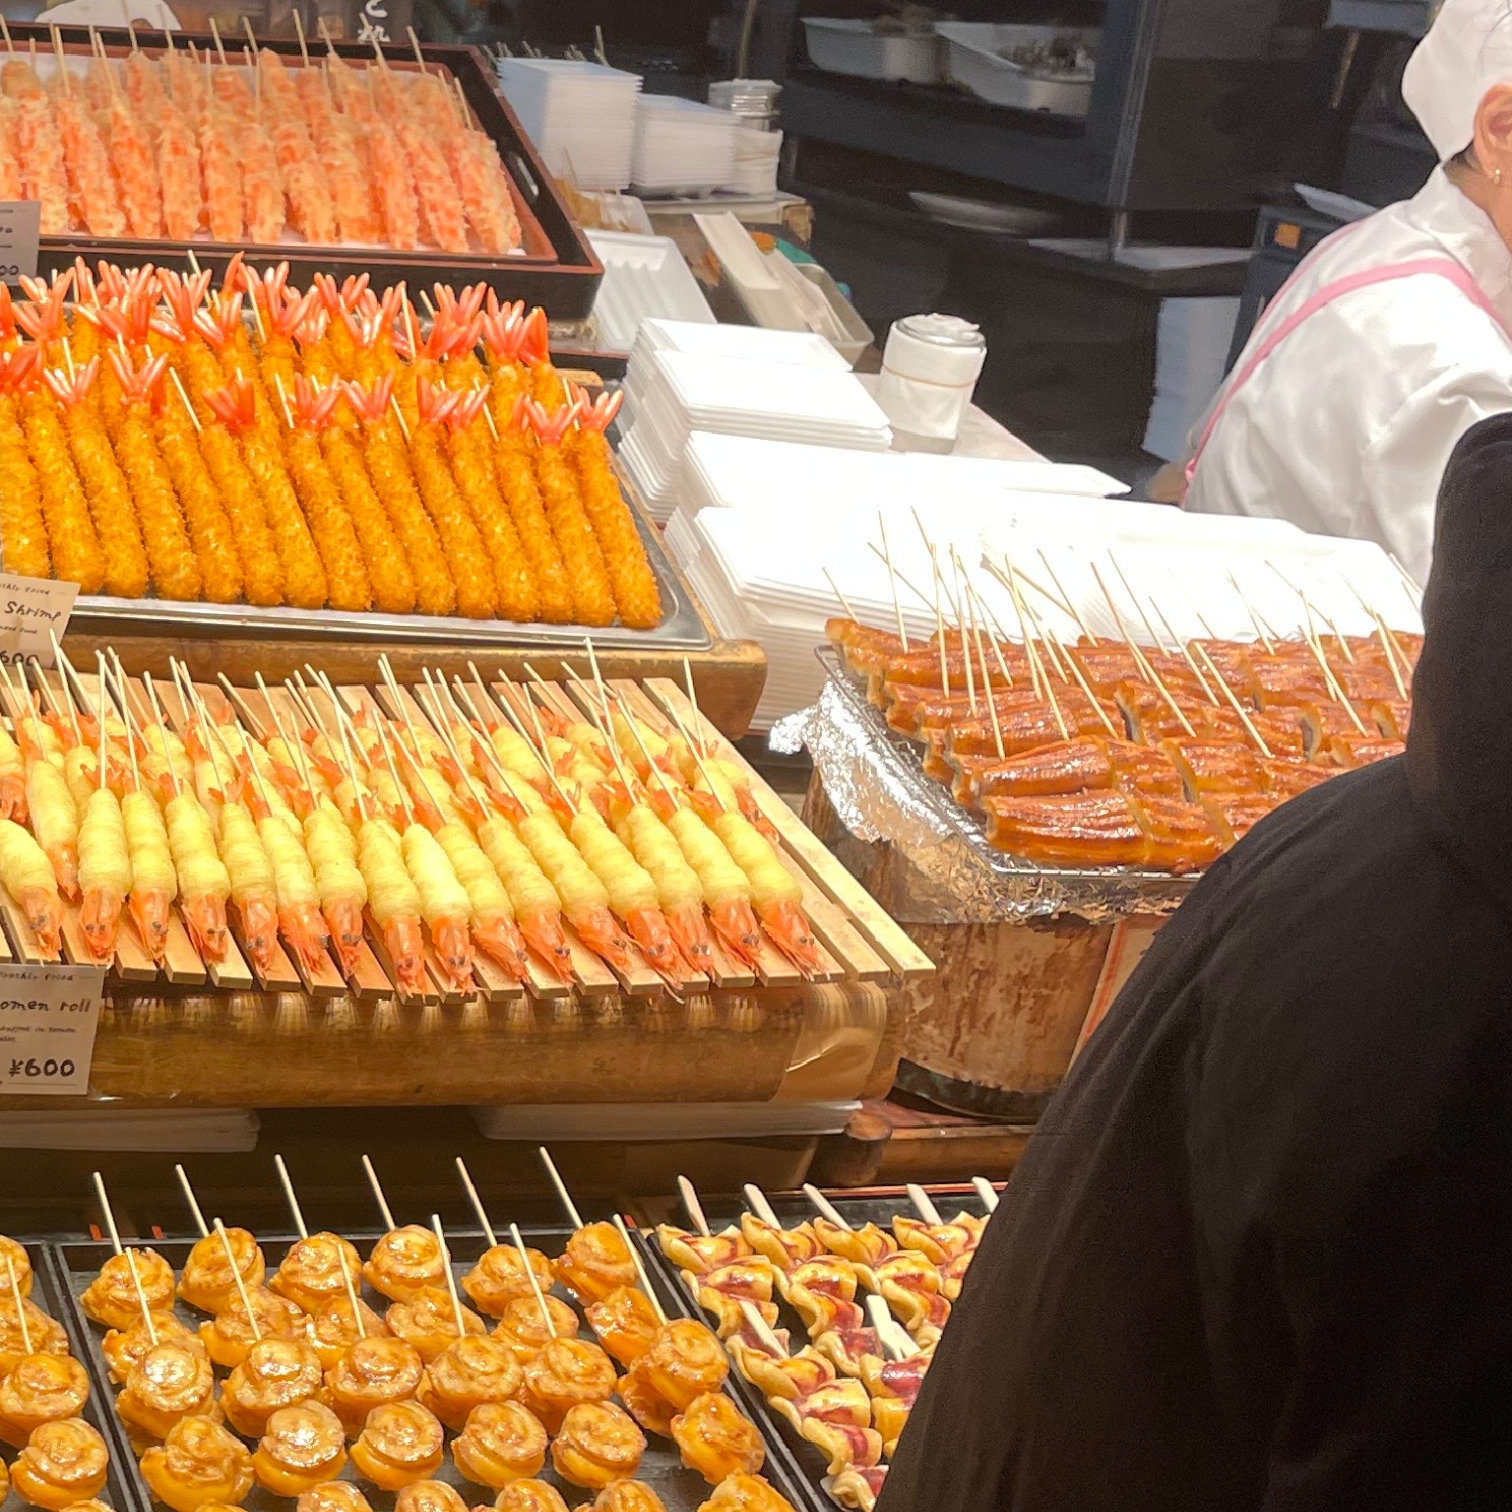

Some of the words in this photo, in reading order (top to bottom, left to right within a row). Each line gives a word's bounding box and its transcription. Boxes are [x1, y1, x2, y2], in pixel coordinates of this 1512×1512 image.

[4, 600, 62, 622] Shrimp
[59, 997, 92, 1014] roll
[8, 1057, 76, 1078] ¥600
